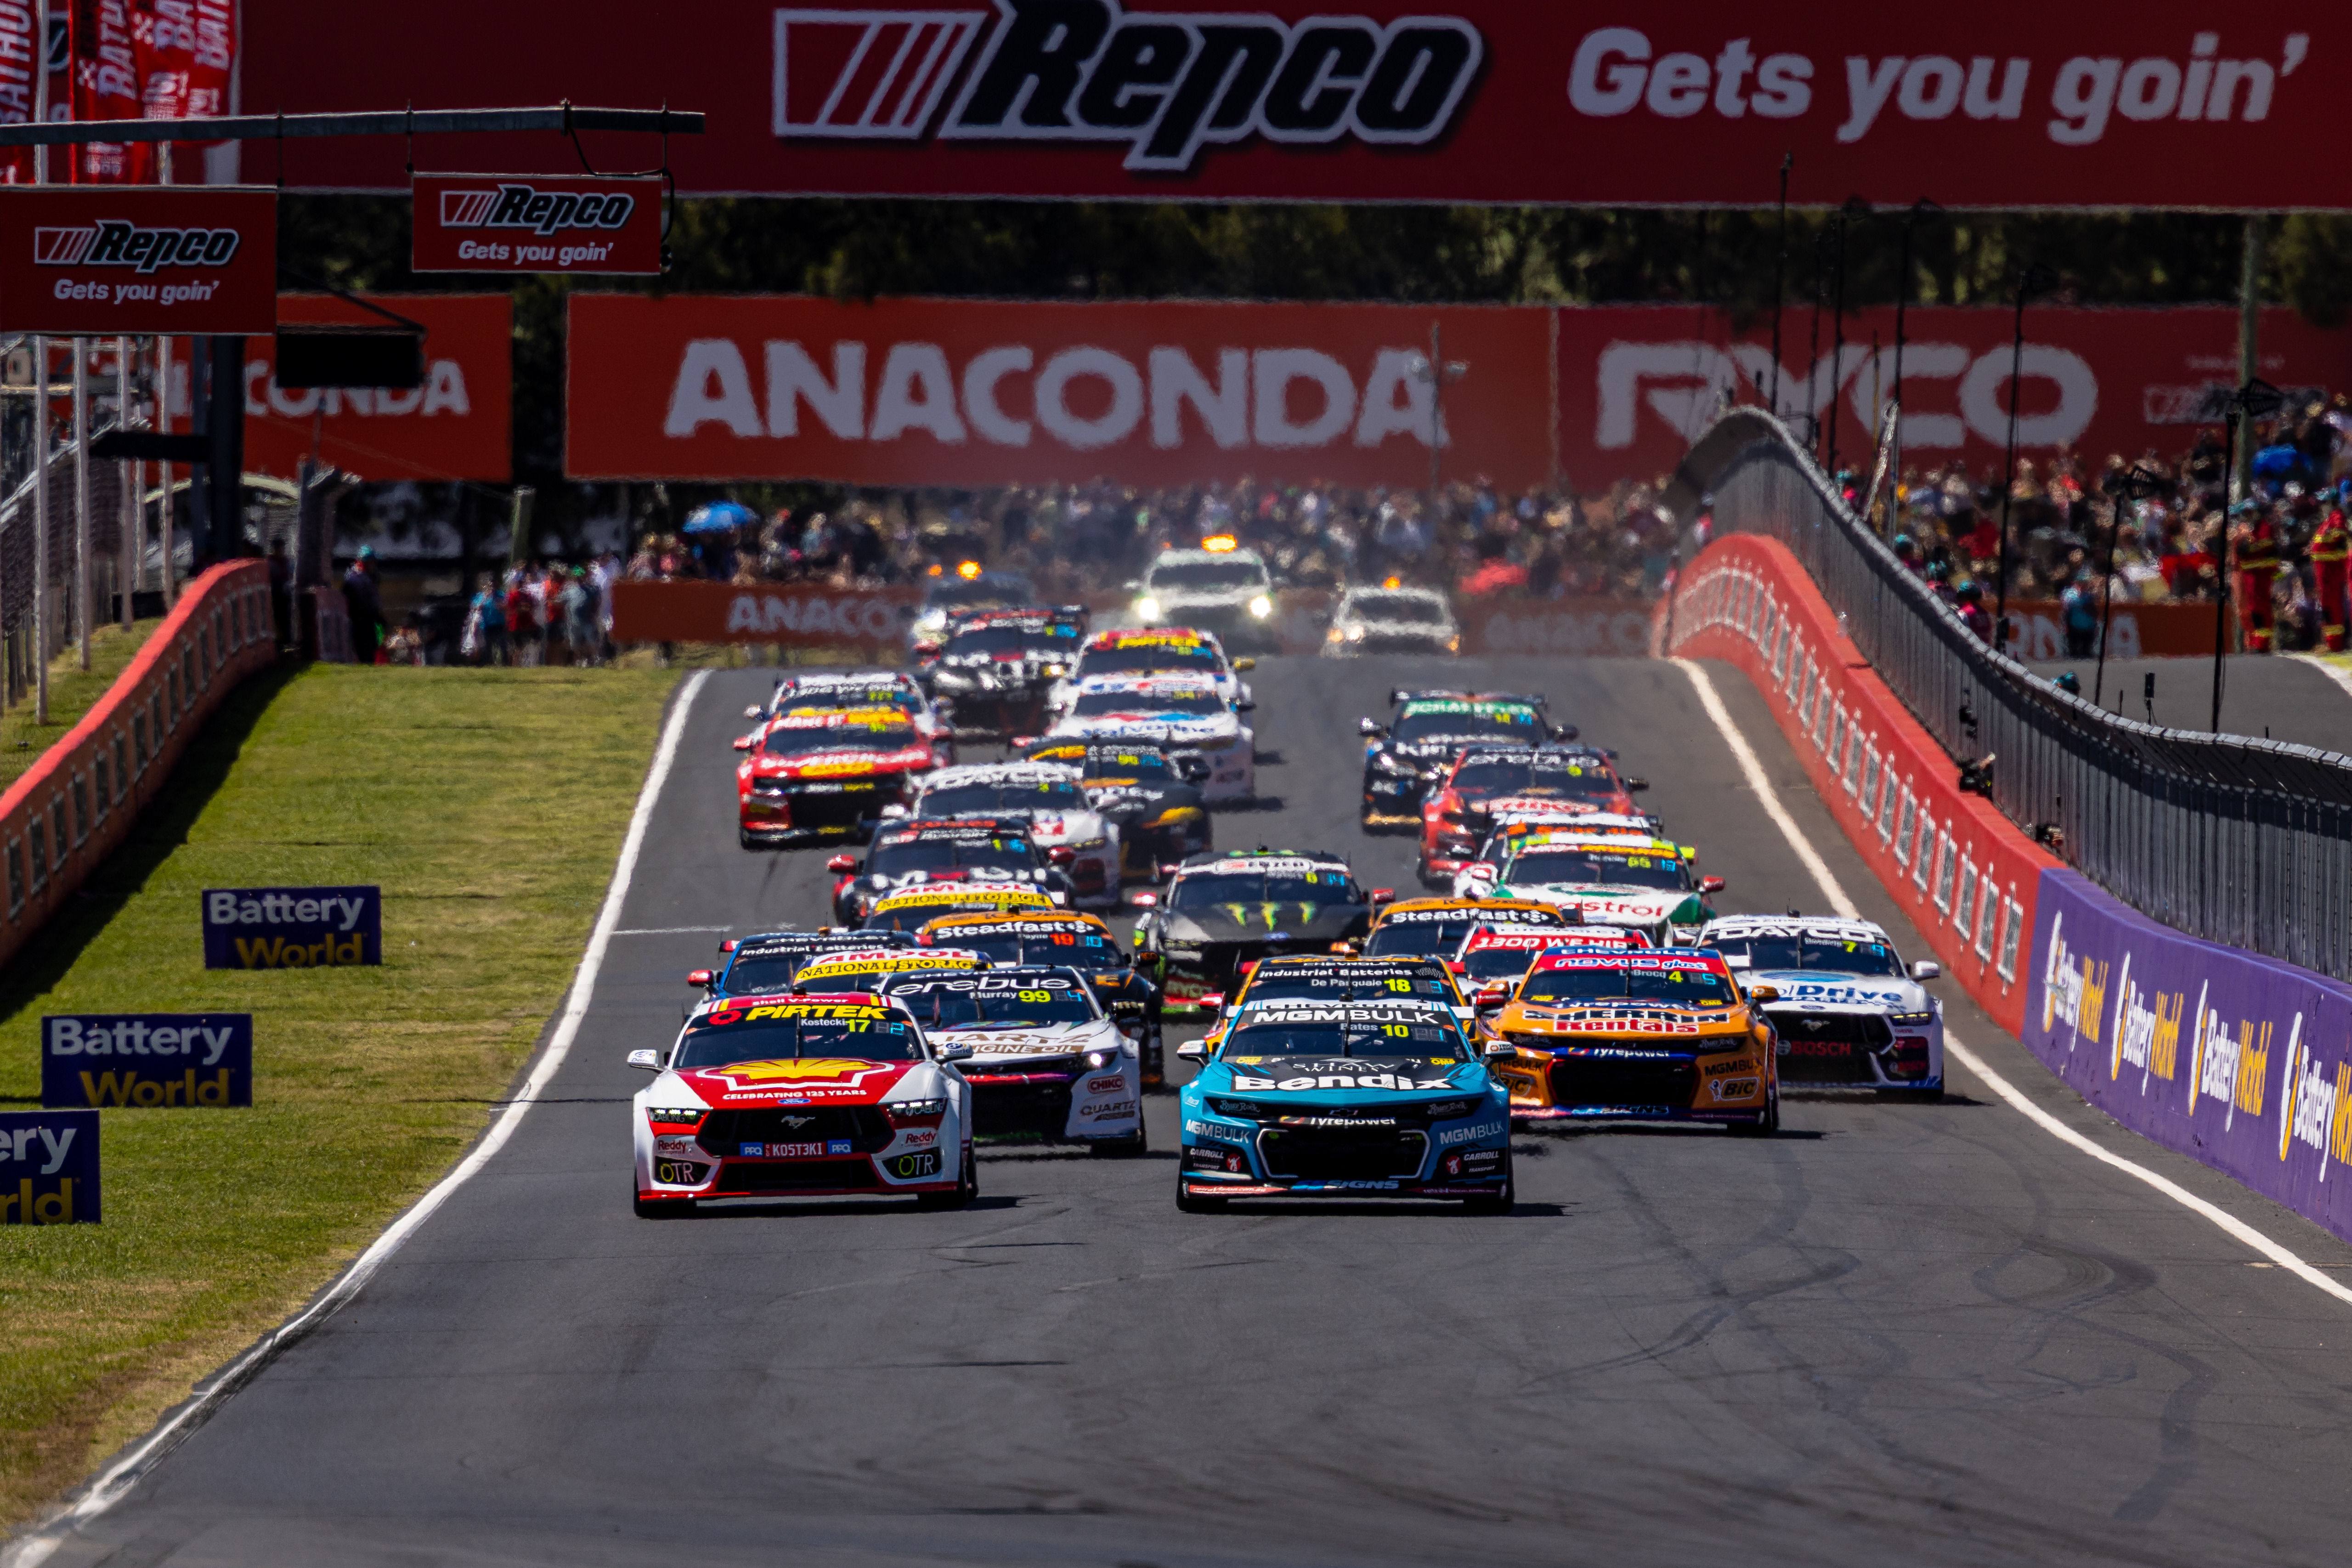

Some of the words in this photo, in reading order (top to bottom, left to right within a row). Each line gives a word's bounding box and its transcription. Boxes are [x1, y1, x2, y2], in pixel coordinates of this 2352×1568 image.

[938, 0, 1483, 170] Repco
[1567, 26, 1815, 119] Gets
[1836, 55, 2030, 143] you
[486, 184, 634, 235] Repco
[84, 220, 240, 273] Repco
[459, 240, 509, 260] Gets
[514, 245, 555, 265] you
[54, 279, 108, 300] Gets
[114, 283, 156, 305] you
[663, 338, 1453, 450] ANACONDA
[209, 893, 309, 931] Battery
[1391, 908, 1519, 923] steadfast
[936, 921, 1065, 940] steadfast
[1718, 926, 1875, 943] DAYCO
[1050, 933, 1074, 945] 19
[1475, 938, 1541, 949] 1300
[1545, 937, 1582, 948] WE
[1843, 940, 1857, 952] 7
[235, 933, 362, 968] World
[741, 945, 810, 956] Industrial
[819, 949, 973, 964] AMPOL
[1561, 948, 1703, 957] CHEVROLET
[800, 960, 894, 979] NATIONAL
[1259, 968, 1333, 978] Industrial
[1339, 968, 1412, 976] Batteries
[1669, 971, 1683, 983] 4
[890, 976, 1072, 996] erebus
[1384, 979, 1411, 992] 18
[1702, 974, 1717, 985] 5
[969, 991, 1017, 1000] Murray
[1019, 991, 1051, 1002] 99
[1066, 990, 1083, 1002] 4
[746, 1005, 890, 1021] PIRTEK
[1253, 1010, 1439, 1024] MGMBULK
[846, 1019, 871, 1033] 17
[1340, 1022, 1378, 1031] Bates
[1381, 1024, 1409, 1038] 10
[51, 1019, 232, 1065] Battery
[1041, 1045, 1078, 1053] OIL
[1791, 1041, 1852, 1056] BOSCH
[79, 1068, 229, 1107] World
[1089, 1078, 1123, 1091] CHIKO
[1235, 1074, 1452, 1091] Bendix
[1724, 1082, 1755, 1097] BIC
[722, 1092, 803, 1100] CELEBRATING
[1080, 1100, 1136, 1116] QUARTZ
[905, 1132, 937, 1144] Reddy
[1186, 1119, 1250, 1144] MGMBULK
[1440, 1121, 1504, 1144] MGMBULK
[658, 1140, 687, 1154] Reddy
[1190, 1148, 1224, 1159] CARROLL
[1464, 1151, 1500, 1161] CARROLL
[660, 1162, 695, 1183] OTR
[899, 1154, 934, 1176] OTR
